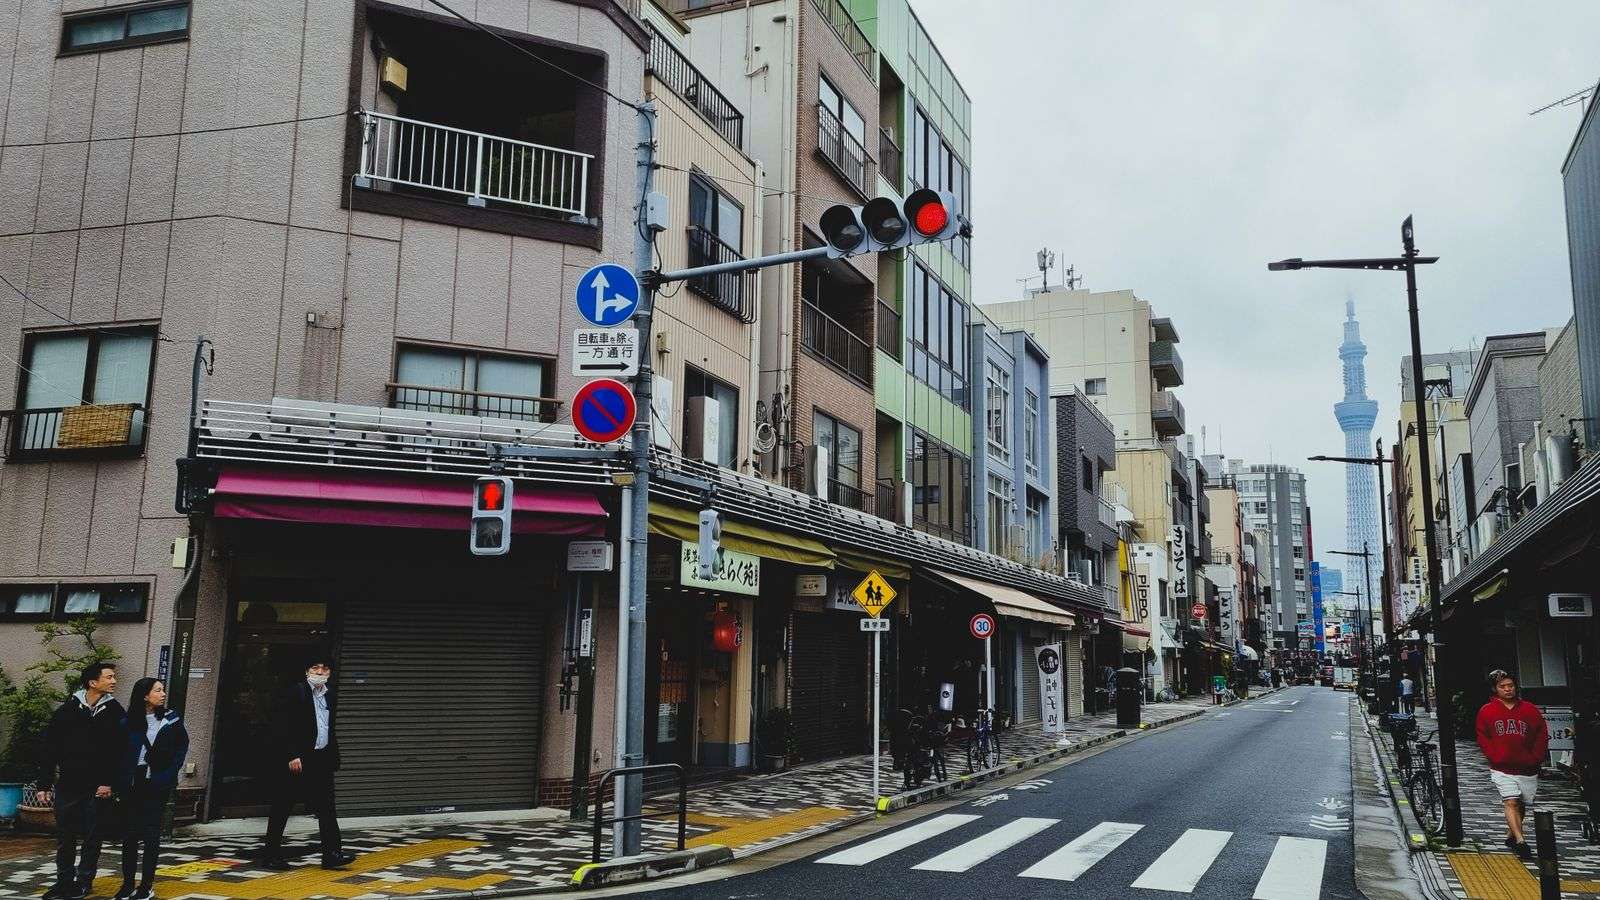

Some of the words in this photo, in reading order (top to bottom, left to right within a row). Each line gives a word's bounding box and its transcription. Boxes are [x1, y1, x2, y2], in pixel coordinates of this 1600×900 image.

[578, 332, 634, 344] 自転車を除く
[578, 346, 634, 358] 一方通行
[863, 621, 887, 629] 通学路
[976, 621, 989, 632] 30
